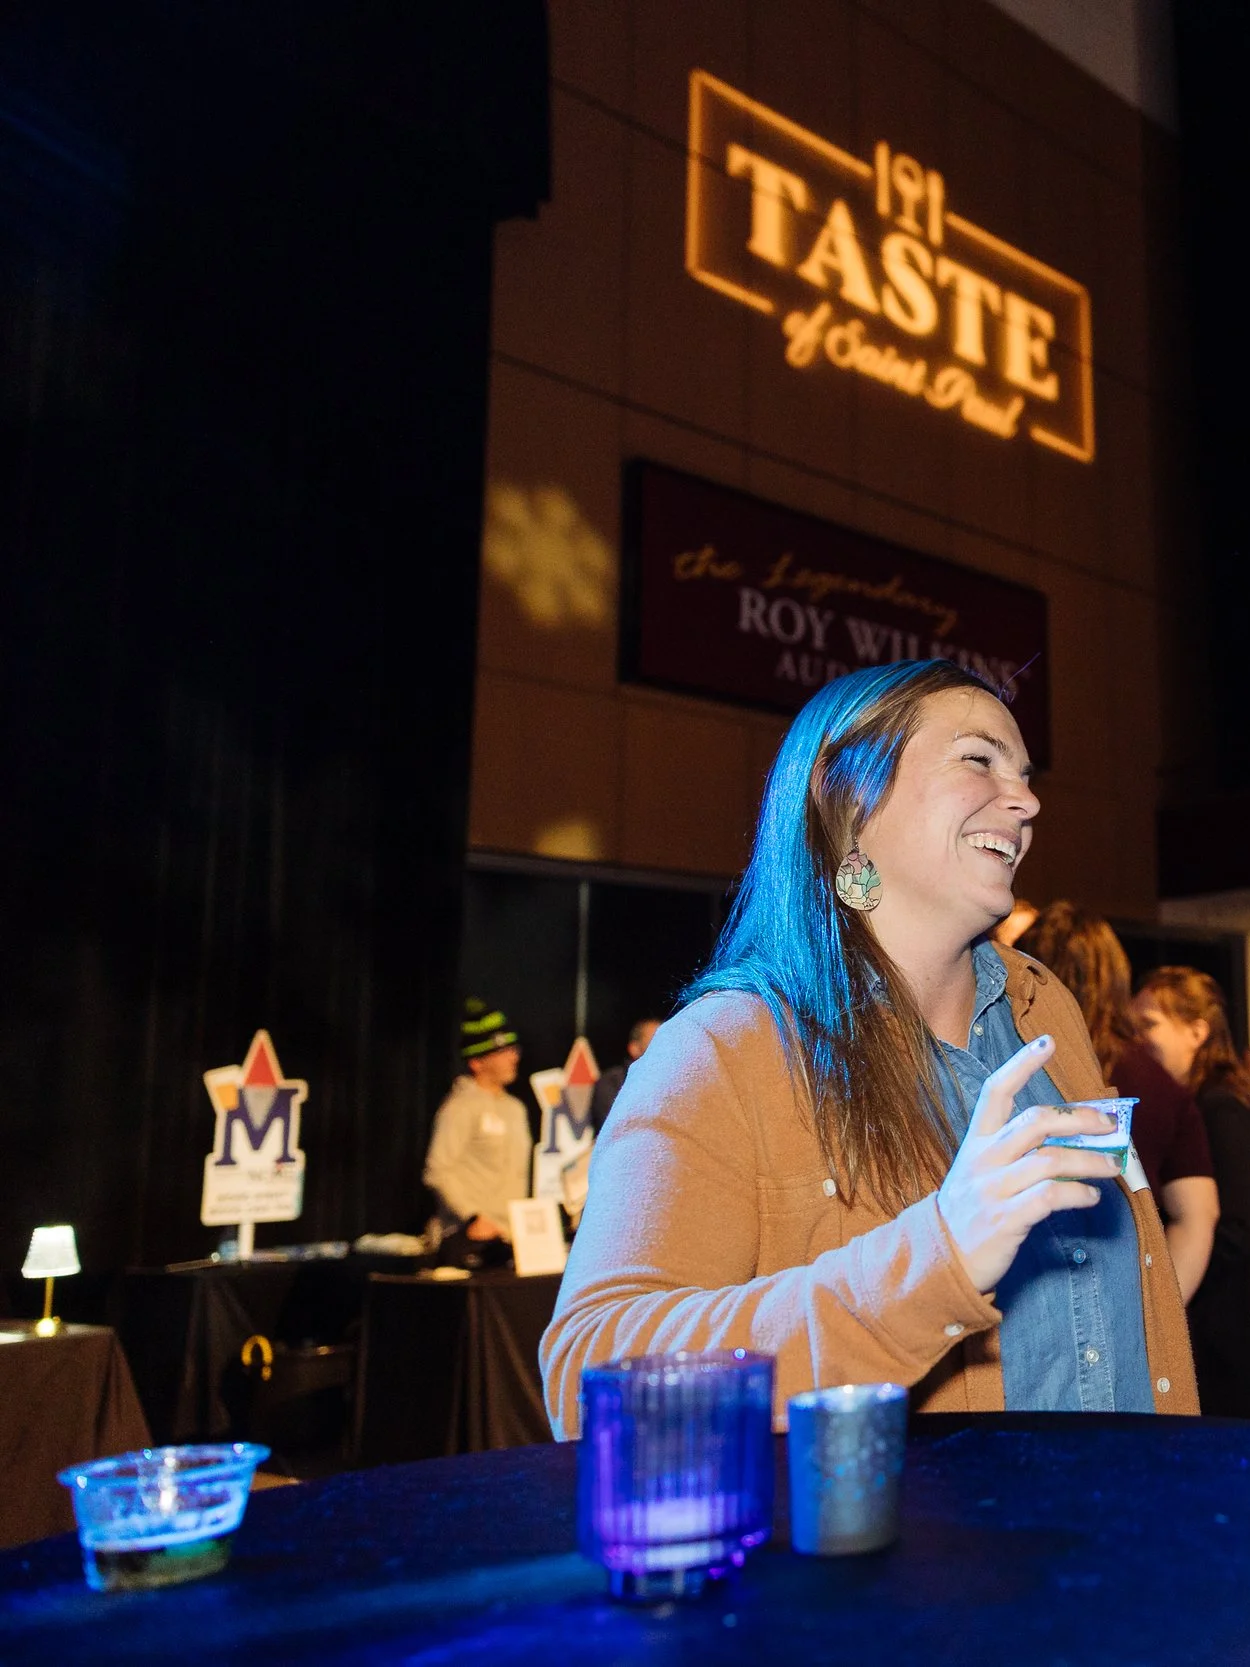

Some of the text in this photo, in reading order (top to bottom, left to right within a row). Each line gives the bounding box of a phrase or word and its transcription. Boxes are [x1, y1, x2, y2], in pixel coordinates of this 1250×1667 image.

[727, 143, 1059, 401] TASTE
[782, 302, 1025, 440] of Saint Paul
[673, 545, 959, 636] the Legendary
[738, 586, 834, 651] ROY
